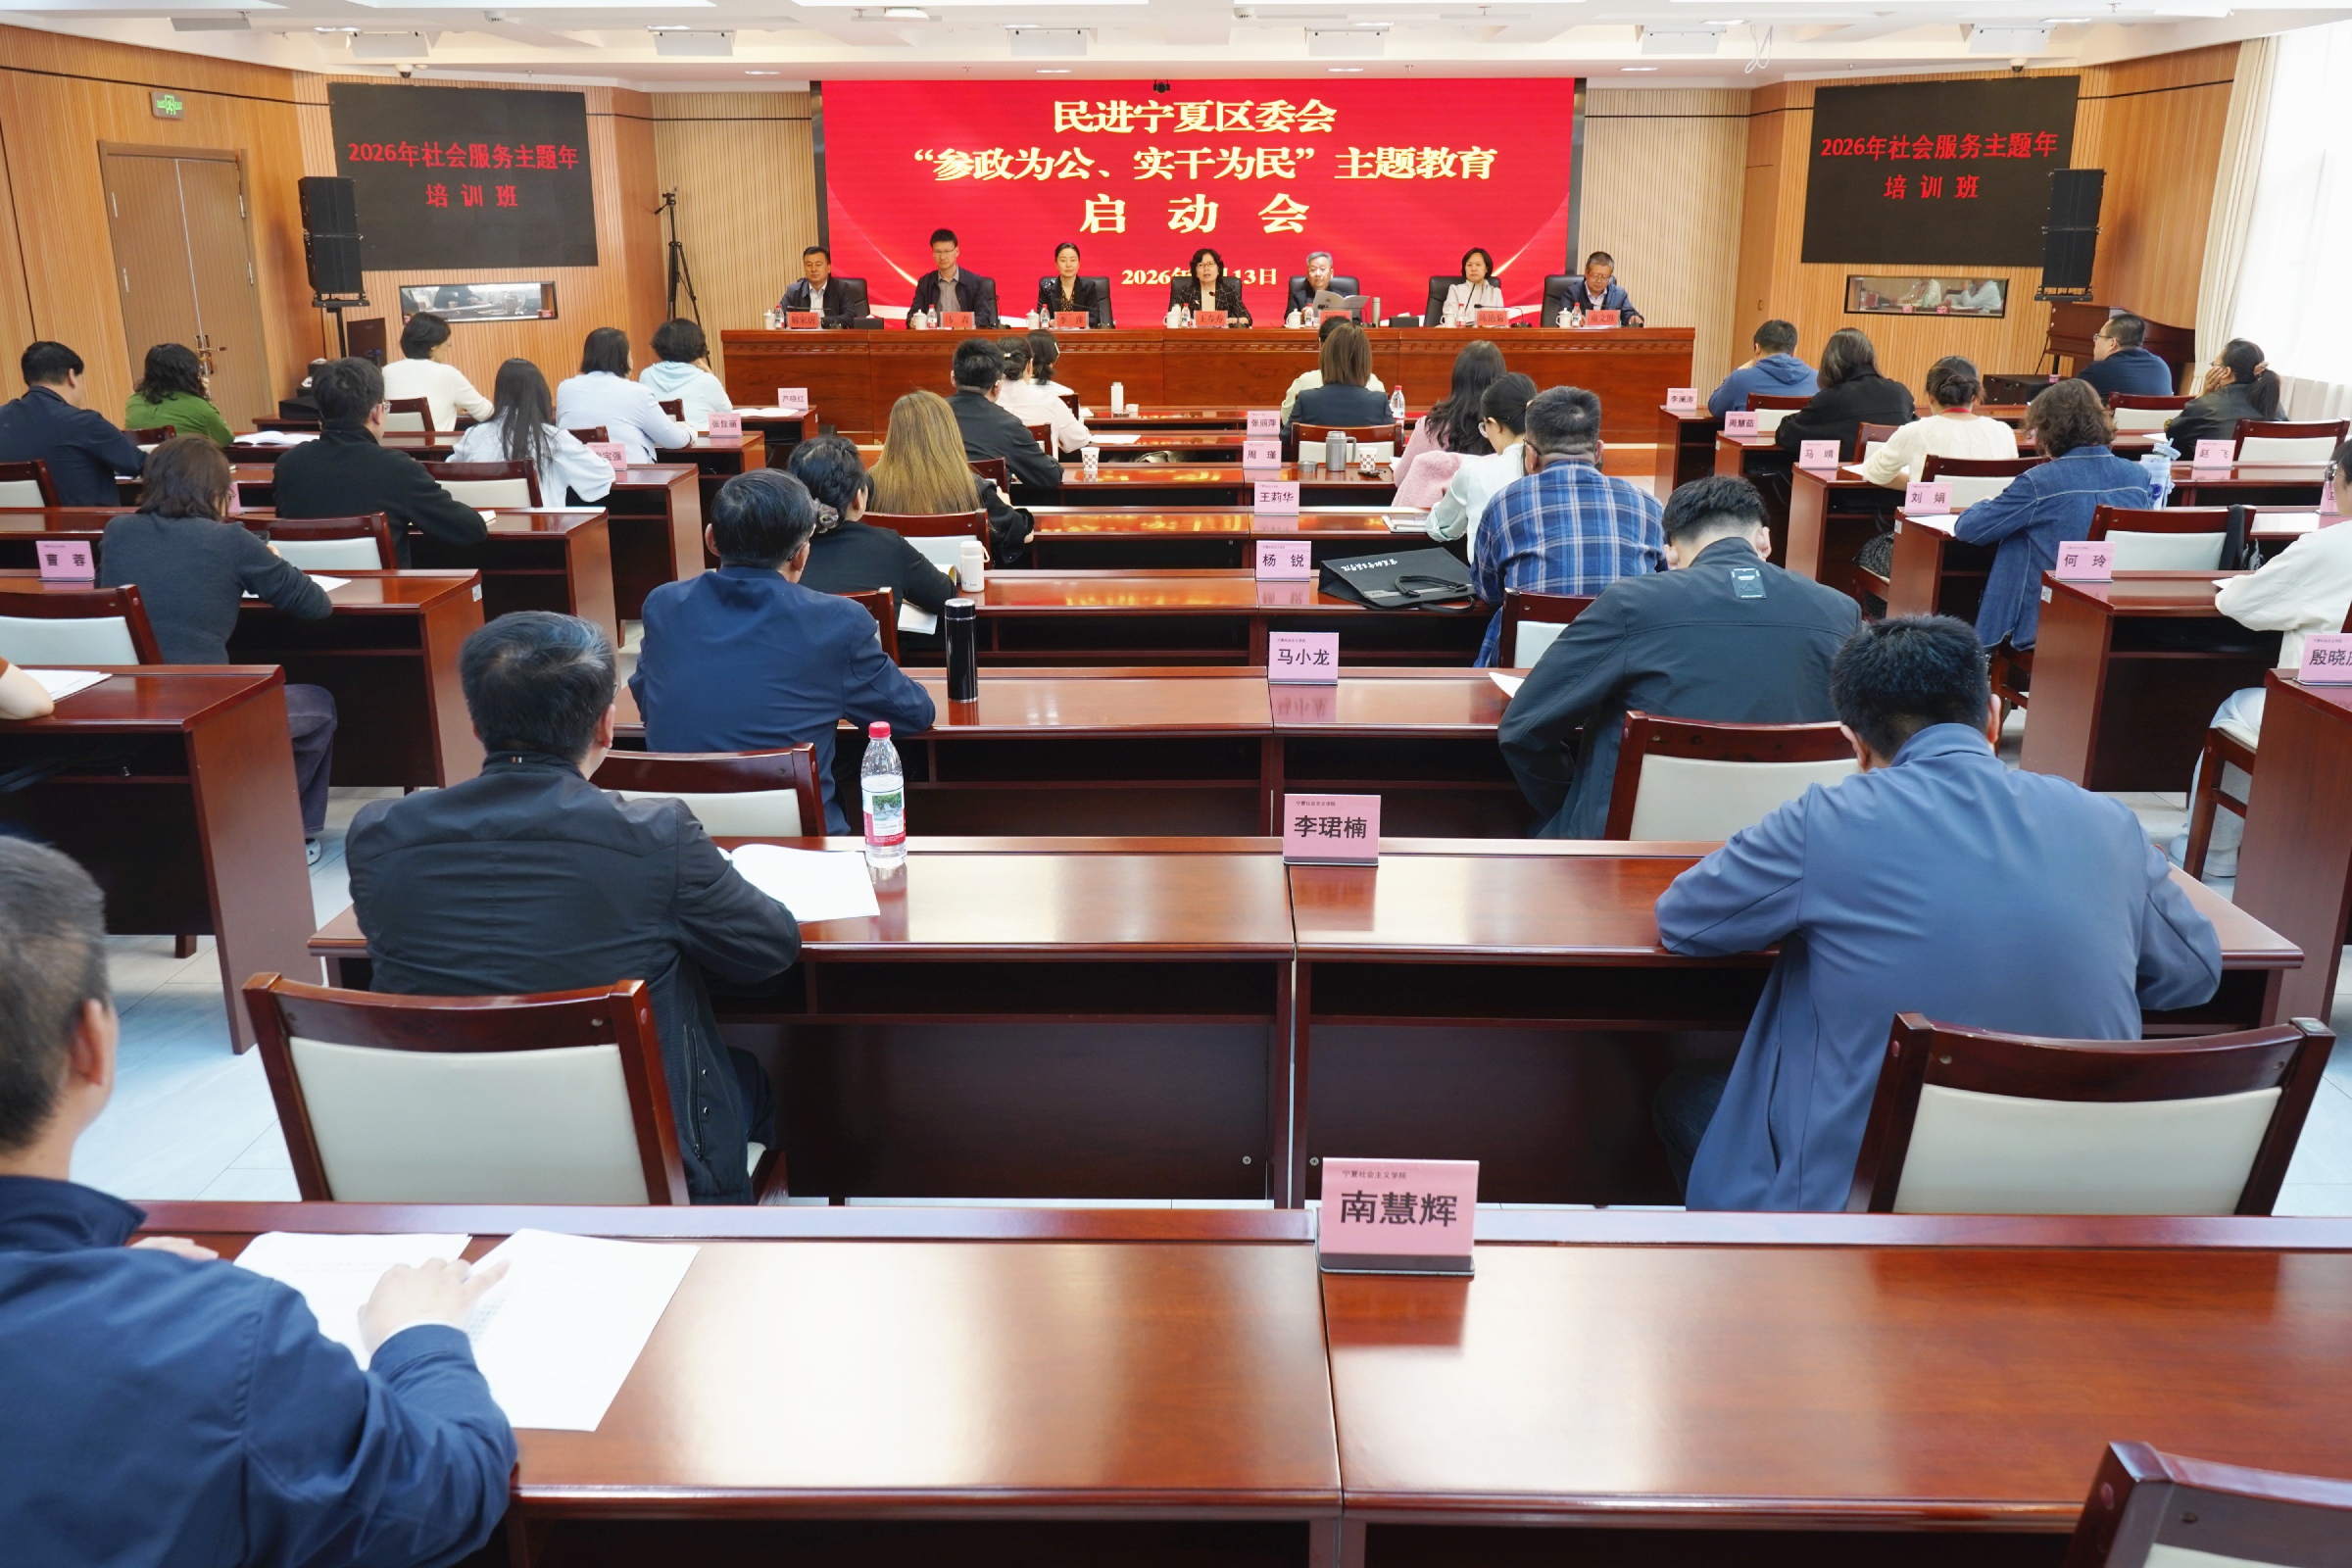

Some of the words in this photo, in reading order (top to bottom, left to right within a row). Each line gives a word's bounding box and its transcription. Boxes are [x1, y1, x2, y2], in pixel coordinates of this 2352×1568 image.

[1054, 98, 1337, 133] 民进宁夏区委会
[348, 141, 578, 170] 2026年社会服务主题年
[1821, 130, 2058, 161] 2026年社会服务主题年
[425, 183, 517, 208] 培训班
[1884, 173, 1980, 200] 培训班
[1079, 192, 1310, 233] 启动会
[2199, 449, 2229, 459] 赵飞
[1259, 491, 1294, 503] 王莉华
[1910, 491, 1946, 504] 刘娟
[45, 554, 86, 566] 曹蓉
[1262, 553, 1304, 567] 杨锐
[2064, 554, 2107, 567] 何玲
[1277, 648, 1330, 665] 马小龙
[1294, 814, 1367, 839] 李珺楠
[1343, 1169, 1407, 1180] 宁夏社会主义学院
[1341, 1190, 1457, 1227] 南慧辉
